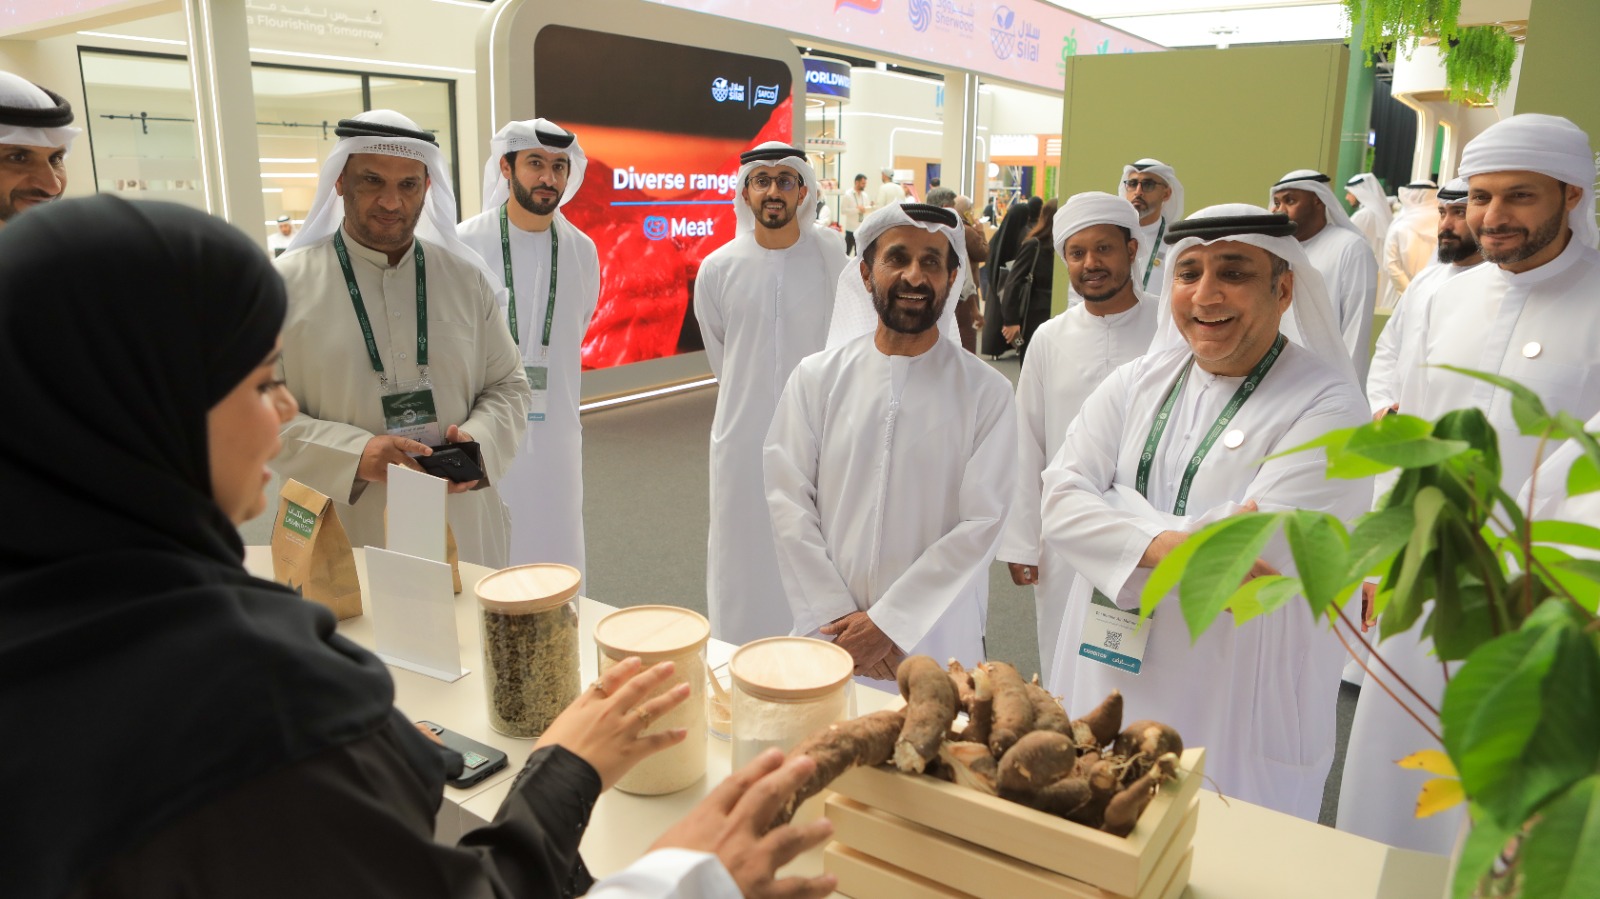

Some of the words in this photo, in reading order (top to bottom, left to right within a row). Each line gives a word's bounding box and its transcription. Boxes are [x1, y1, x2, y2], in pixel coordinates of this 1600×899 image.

[257, 15, 325, 35] Flourishing
[327, 23, 383, 39] Tomorrow
[935, 11, 974, 32] Sherwood
[613, 167, 685, 190] Diverse
[690, 173, 737, 194] range
[671, 217, 714, 237] Meat
